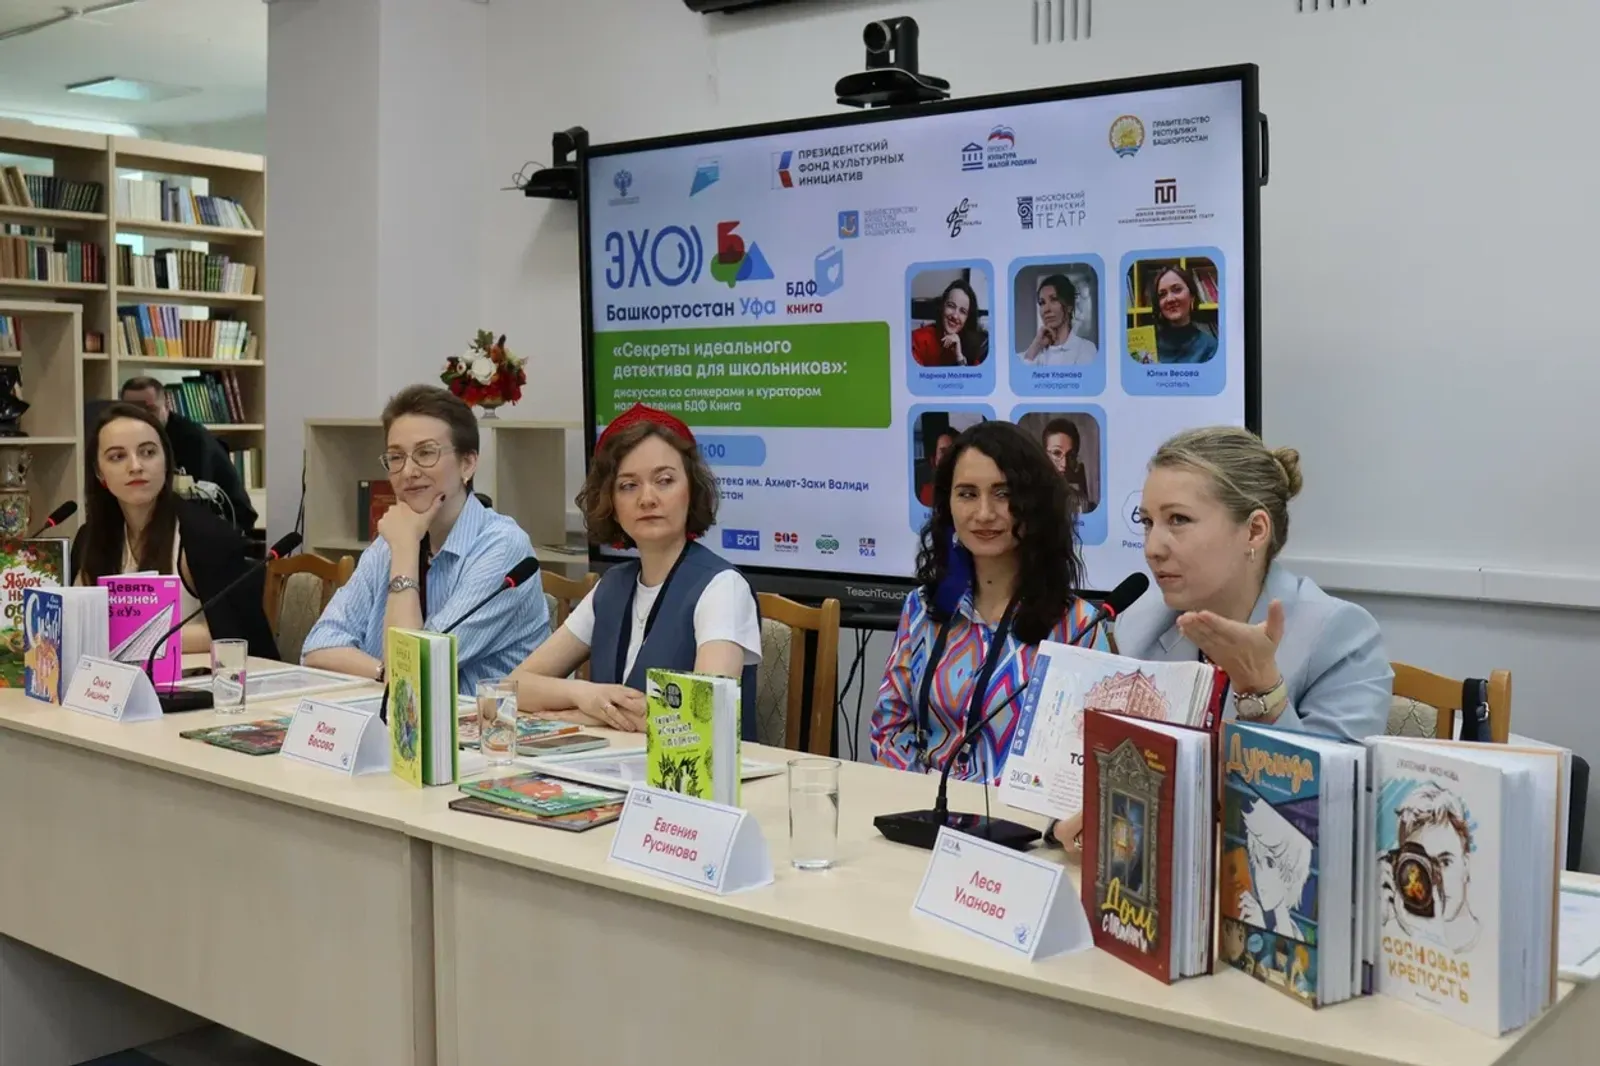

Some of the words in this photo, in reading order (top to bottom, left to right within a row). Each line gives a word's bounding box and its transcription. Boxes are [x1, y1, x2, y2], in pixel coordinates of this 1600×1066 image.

[1152, 115, 1210, 128] ПРАВИТЕЛЬСТВО
[1152, 127, 1197, 137] РЕСПУБЛИКИ
[1152, 135, 1209, 146] БАШКОРТОСТАН
[798, 140, 889, 160] ПРЕЗИДЕНТСКИЙ
[798, 160, 830, 174] ФОНД
[832, 152, 905, 170] КУЛЬТУРНЫХ
[798, 171, 863, 187] ИНИЦИАТИВ
[1035, 191, 1086, 203] МОСКОВСКИЙ
[1035, 200, 1087, 212] ГУБЕРНСКИЙ
[1036, 210, 1087, 229] ТЕАТР
[786, 279, 818, 298] БДФ
[606, 300, 735, 324] Башкортостан
[739, 297, 777, 320] Уфа
[786, 301, 823, 316] книга
[613, 341, 690, 360] «Секреты
[694, 339, 792, 355] идеального
[613, 363, 692, 380] детектива
[696, 363, 725, 379] для
[729, 359, 848, 377] школьников»:
[919, 372, 946, 380] Марина
[1032, 371, 1050, 379] Леся
[1146, 369, 1168, 378] Юлия
[1169, 369, 1200, 378] Весова
[613, 387, 667, 400] дискуссия
[669, 387, 682, 398] со
[684, 386, 745, 400] спикерами
[747, 386, 754, 397] и
[756, 386, 822, 399] куратором
[684, 400, 708, 413] БДФ
[709, 400, 742, 412] Книга
[746, 477, 763, 487] им.
[764, 477, 826, 490] Ахмет-Заки
[828, 479, 869, 491] Валиди
[736, 534, 759, 548] БСТ
[859, 547, 876, 557] 90.6
[107, 581, 155, 595] Девять
[109, 593, 159, 605] жизней
[92, 675, 111, 690] Ольга
[83, 687, 110, 703] Лишина
[315, 720, 337, 736] Юлия
[307, 733, 335, 752] Весова
[653, 815, 698, 842] Евгения
[642, 834, 698, 863] Русинова
[968, 870, 1003, 895] Леся
[954, 885, 1007, 921] Уланова
[1382, 935, 1470, 981] СОСНОВАЯ
[1388, 957, 1470, 1005] КРЕПОСТЬ
